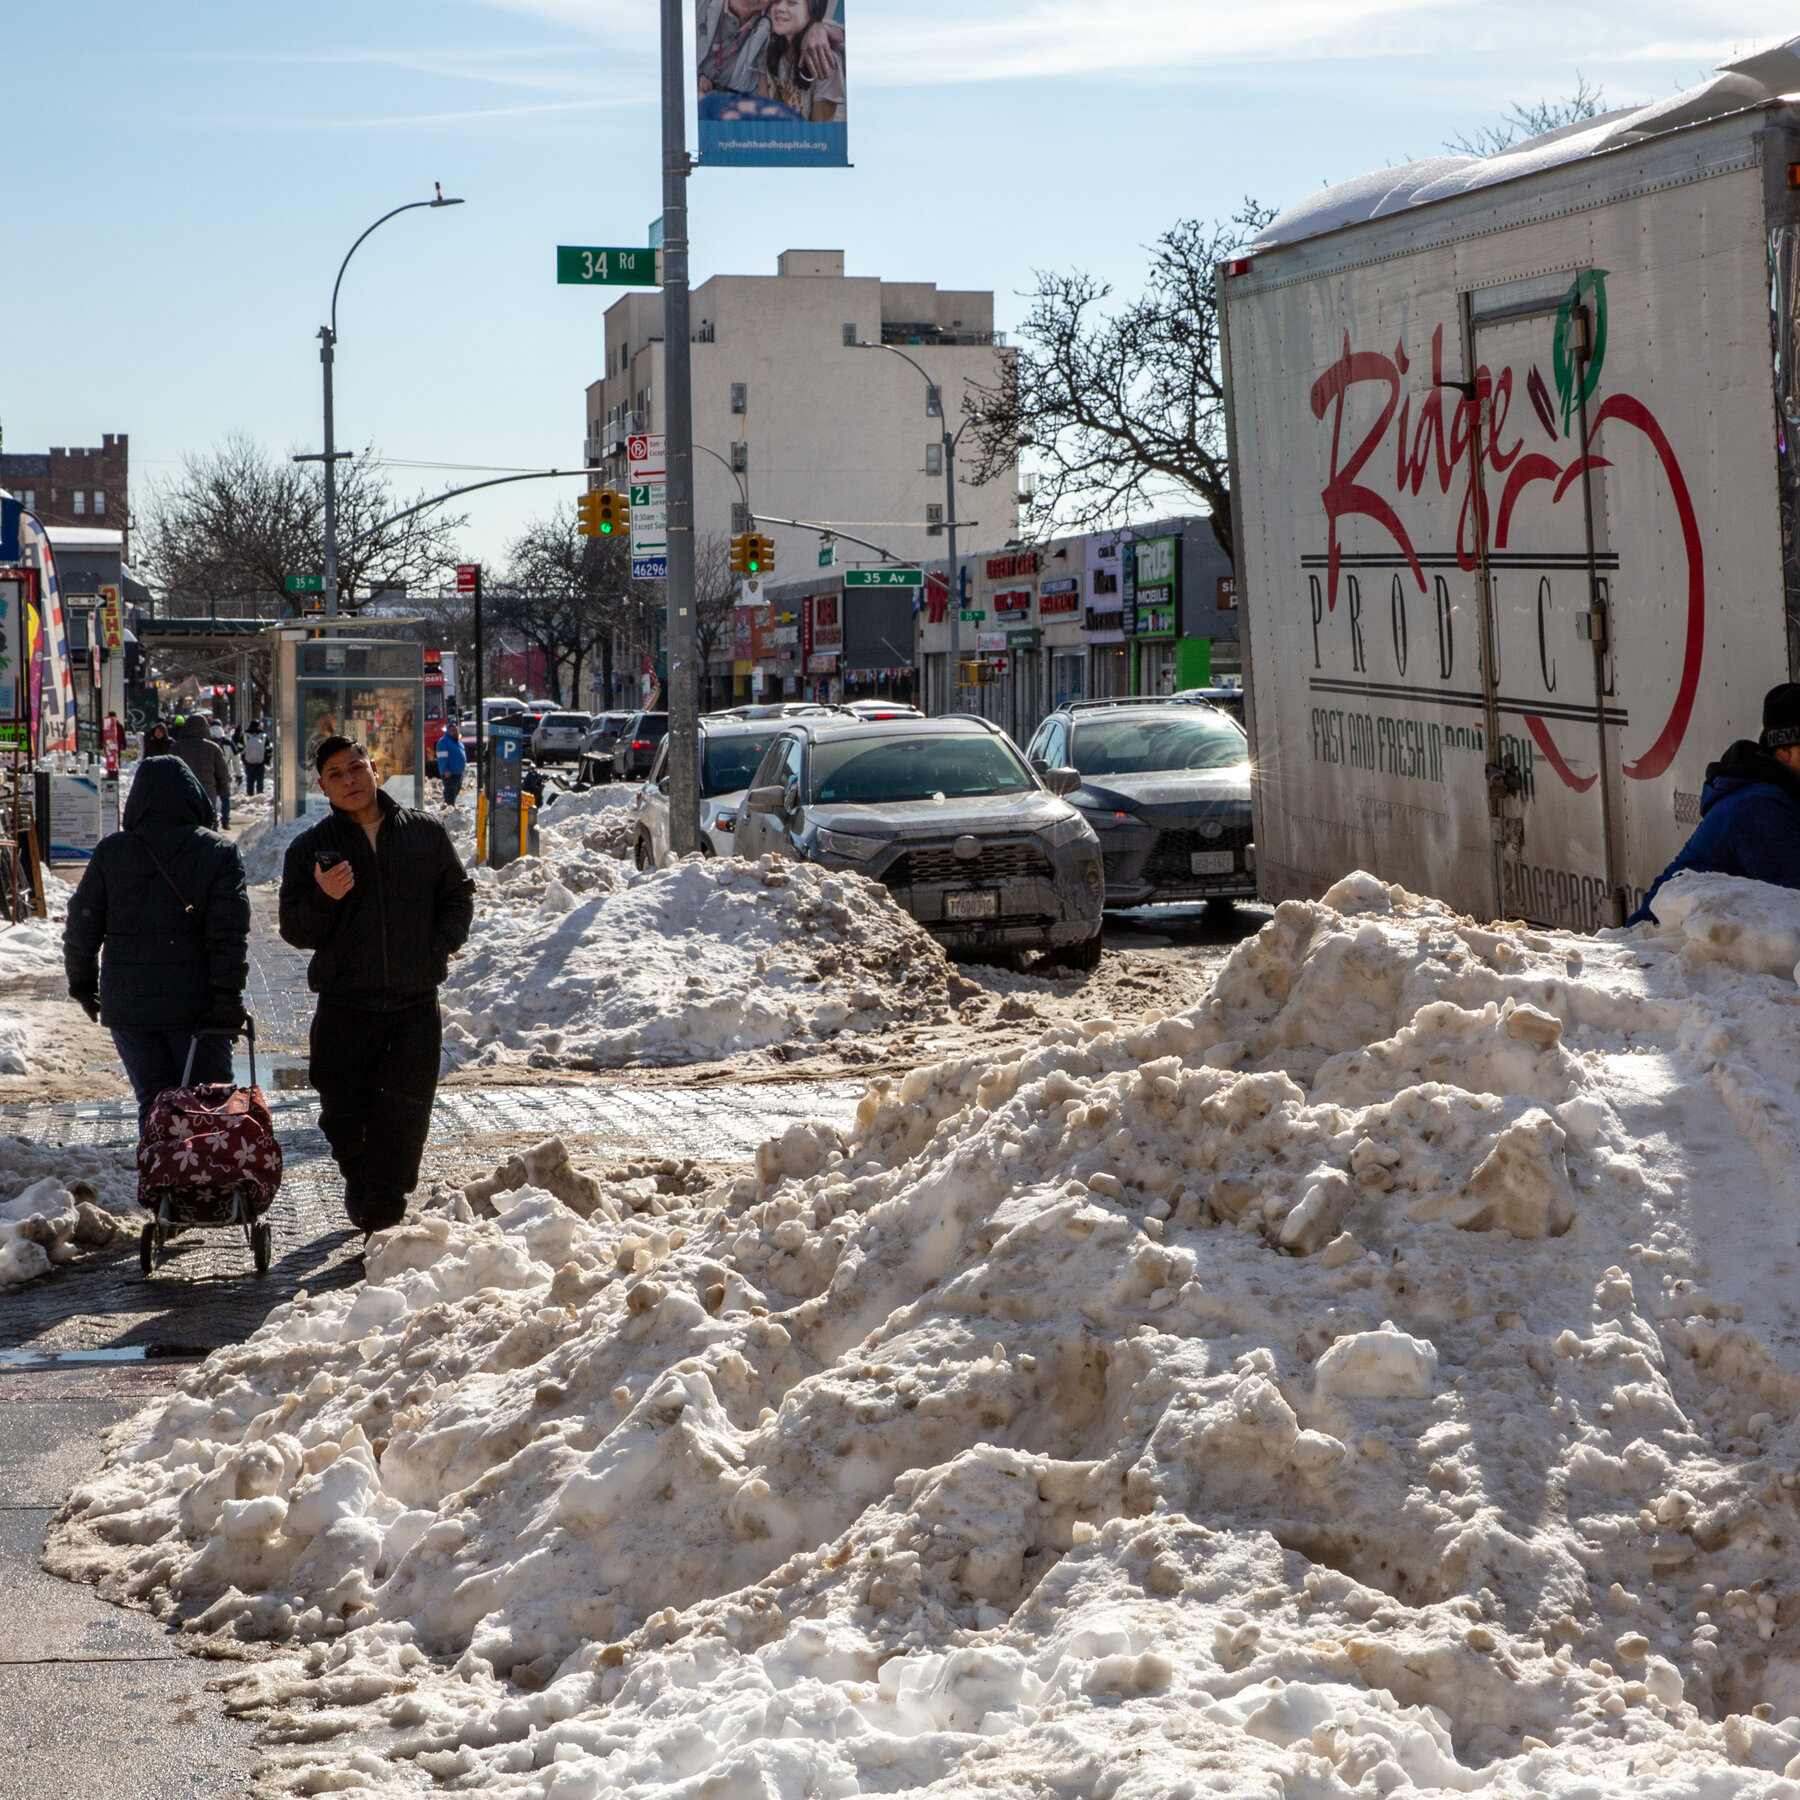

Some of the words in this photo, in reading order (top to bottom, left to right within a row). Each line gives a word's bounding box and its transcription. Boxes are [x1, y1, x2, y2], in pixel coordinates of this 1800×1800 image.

[718, 138, 827, 151] nychealthandhospitals.org
[581, 250, 608, 279] 34
[619, 252, 635, 269] Rd
[635, 486, 645, 505] 2
[634, 513, 655, 521] 8:30am
[634, 523, 653, 531] Except
[296, 578, 306, 589] 35
[864, 573, 881, 584] 35
[889, 573, 905, 584] Av
[1137, 588, 1170, 604] MOBILE
[102, 587, 121, 647] OSHA
[504, 740, 517, 760] P
[1312, 706, 1345, 769] FAST
[1348, 714, 1376, 771] AND
[1377, 719, 1427, 781] FRESH
[1427, 725, 1444, 783] IN
